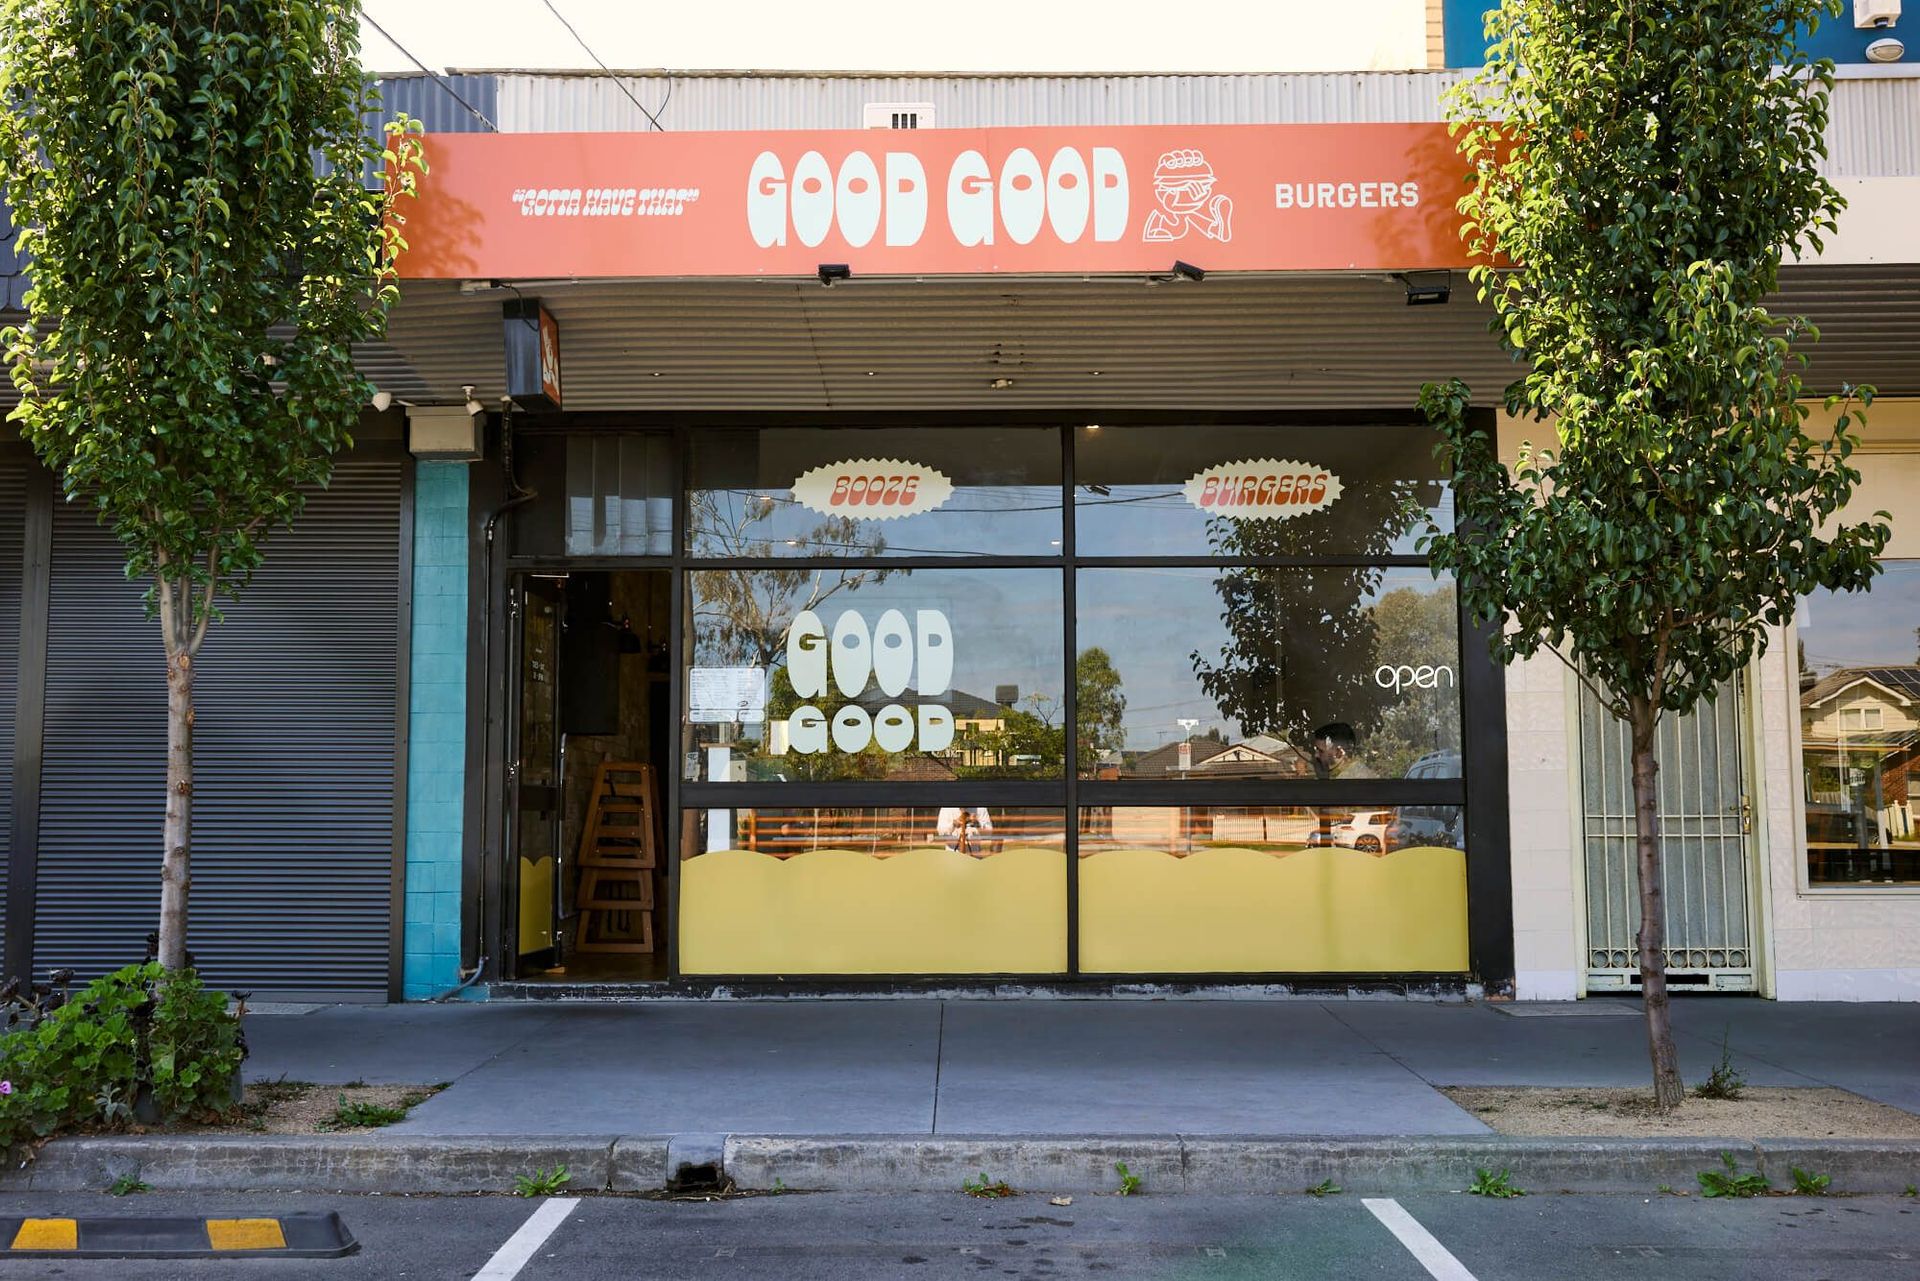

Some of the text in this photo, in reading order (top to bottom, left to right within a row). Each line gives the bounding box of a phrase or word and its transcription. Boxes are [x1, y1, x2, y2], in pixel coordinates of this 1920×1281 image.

[582, 188, 637, 216] HAVE
[746, 146, 1130, 249] GOOD GOOD
[1275, 182, 1420, 209] BURGERS
[830, 474, 921, 506] BOOZE
[1200, 473, 1329, 507] BURGERS
[786, 608, 954, 699] GOOD
[1374, 664, 1454, 696] open
[788, 703, 956, 755] GOOD
